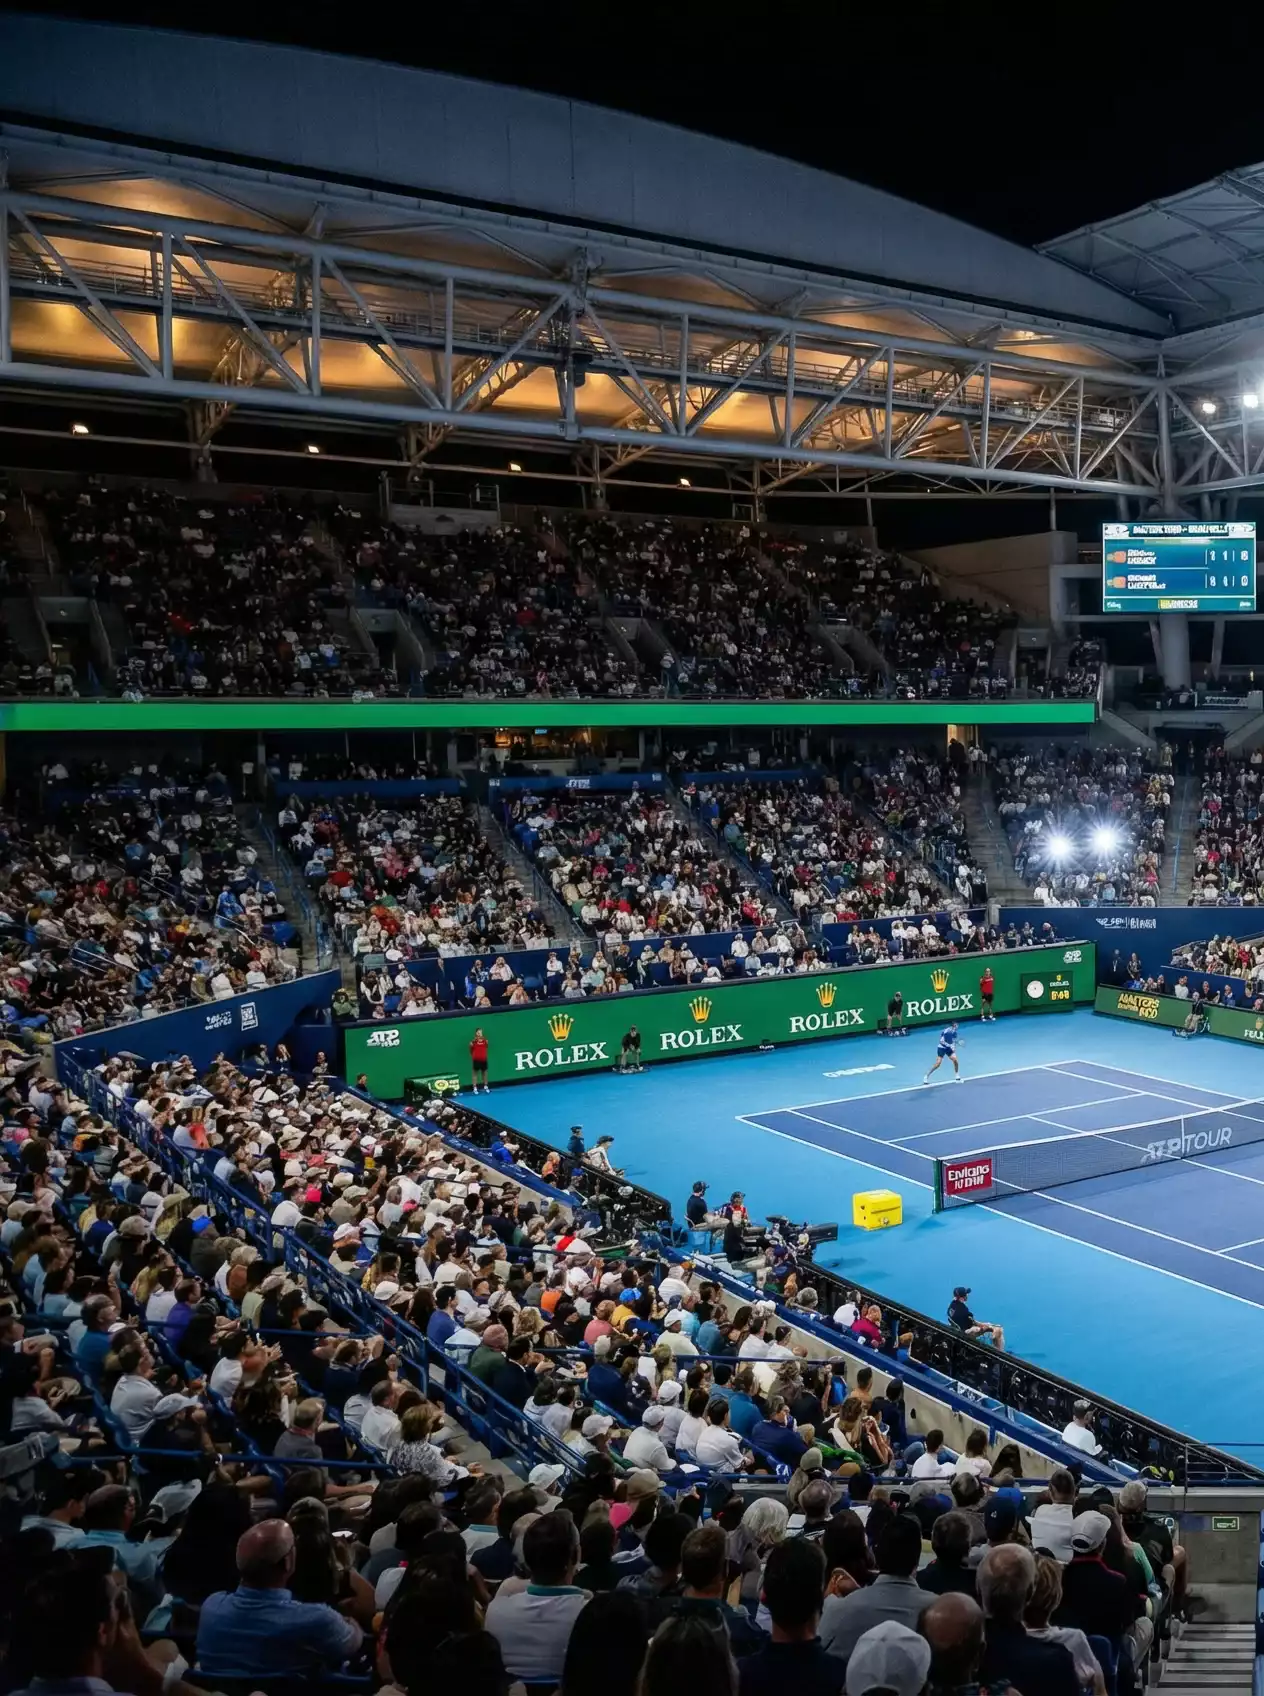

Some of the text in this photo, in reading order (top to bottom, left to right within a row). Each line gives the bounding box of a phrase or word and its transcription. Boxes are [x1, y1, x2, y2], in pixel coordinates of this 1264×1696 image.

[906, 993, 974, 1017] ROLEX
[789, 1008, 865, 1033] ROLEX
[660, 1024, 744, 1050] ROLEX
[515, 1042, 610, 1070] ROLEX
[1184, 1127, 1233, 1153] TOUR
